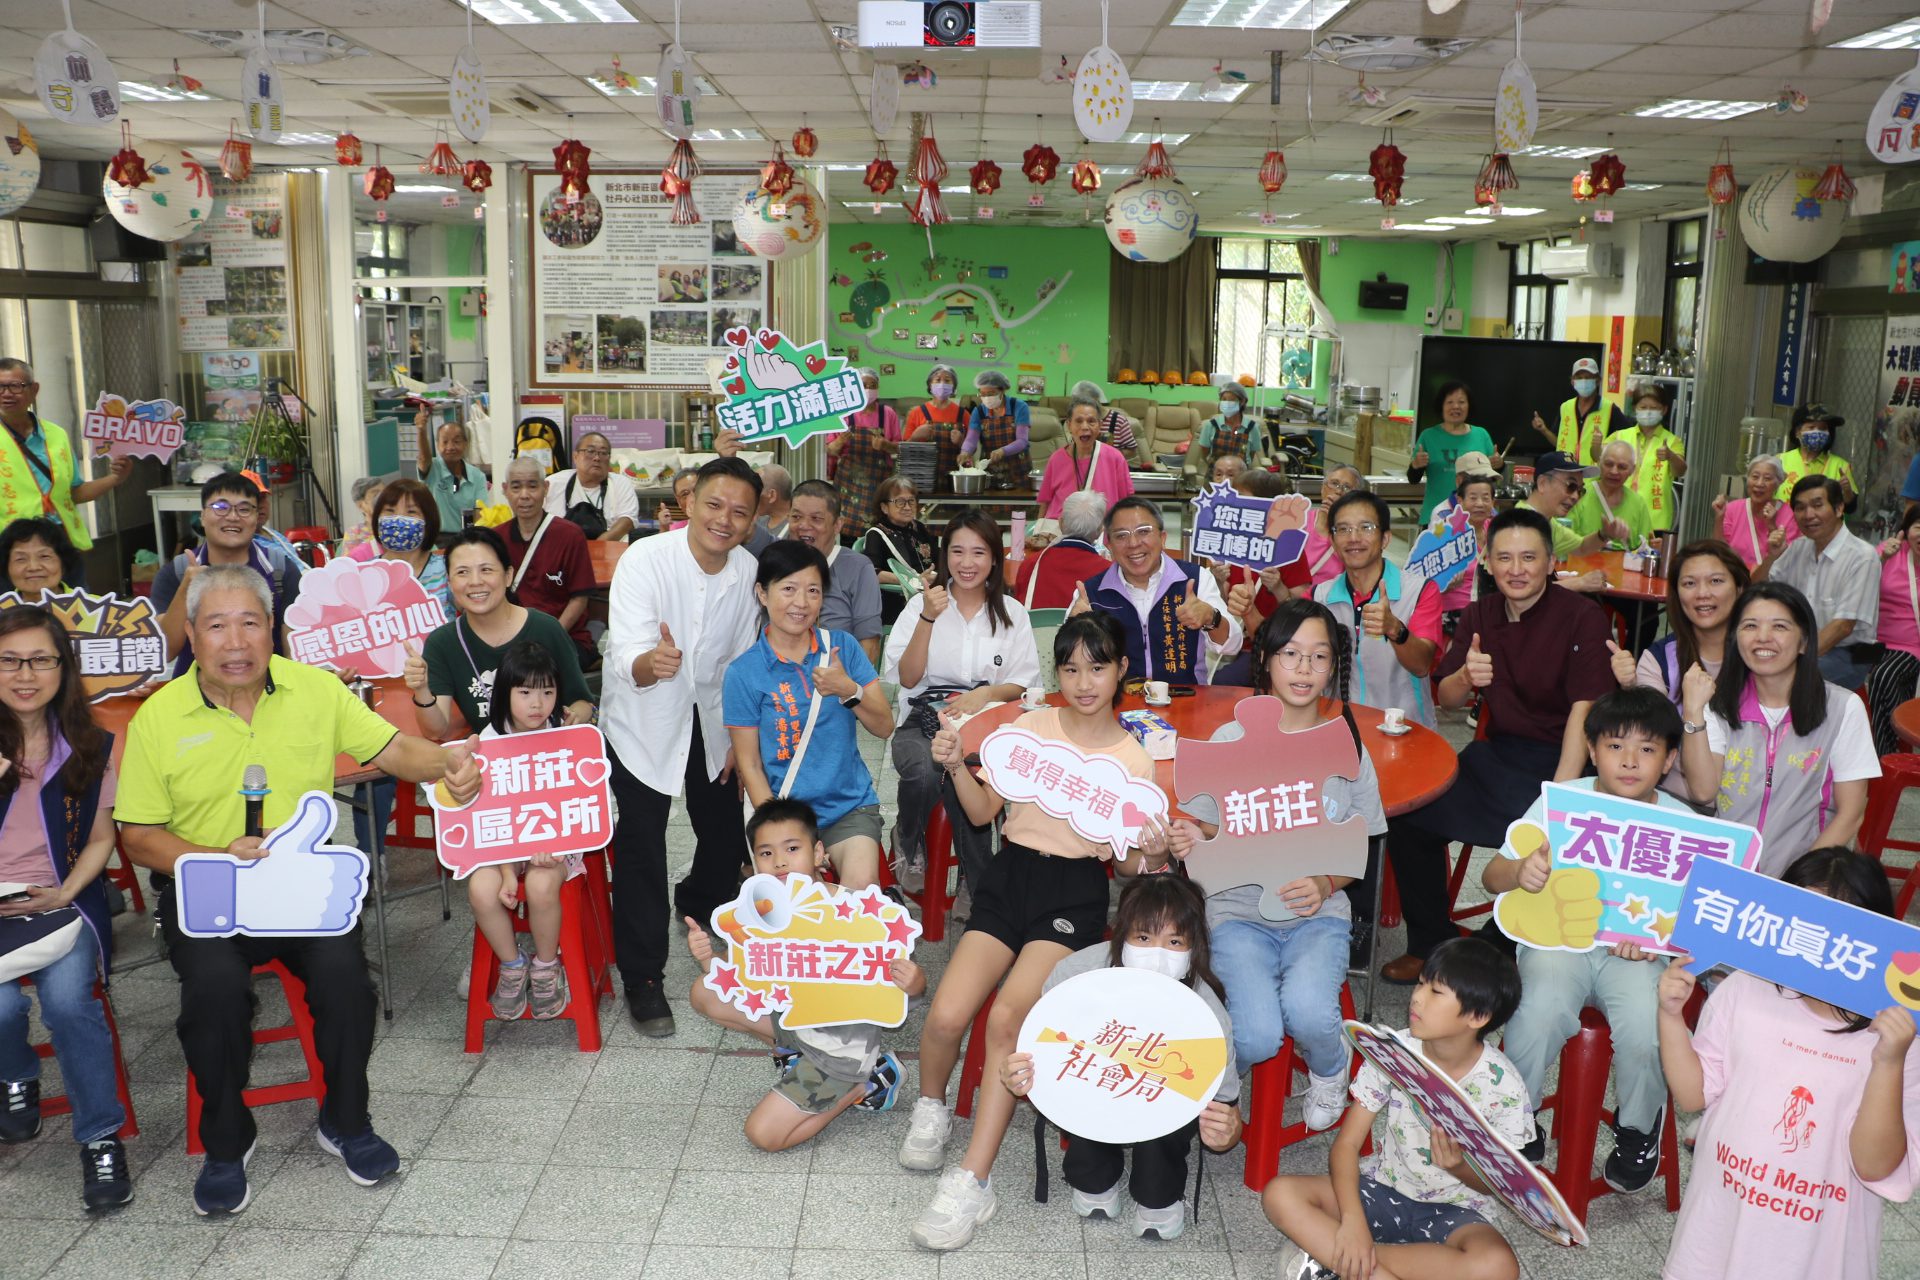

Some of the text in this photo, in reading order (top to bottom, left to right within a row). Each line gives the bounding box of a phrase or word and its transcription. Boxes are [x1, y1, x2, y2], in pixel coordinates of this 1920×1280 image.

[722, 374, 862, 435] 活力滿點
[86, 415, 181, 447] BRAVO
[1213, 504, 1266, 534] 您是
[1196, 530, 1276, 563] 最棒的
[72, 636, 162, 675] 最讚
[295, 600, 444, 664] 感恩的心
[1174, 595, 1187, 669] 新政府社會局
[779, 682, 799, 717] 新莊區
[490, 749, 576, 797] 新莊
[1004, 744, 1121, 821] 覺得幸福
[472, 794, 602, 849] 區公所
[1224, 780, 1319, 836] 新莊
[748, 942, 897, 982] 新莊之光
[1092, 1019, 1168, 1063] 新北
[1782, 1038, 1857, 1066] La mere dansait
[1056, 1040, 1168, 1103] 社會局
[1716, 1140, 1847, 1202] World Marine
